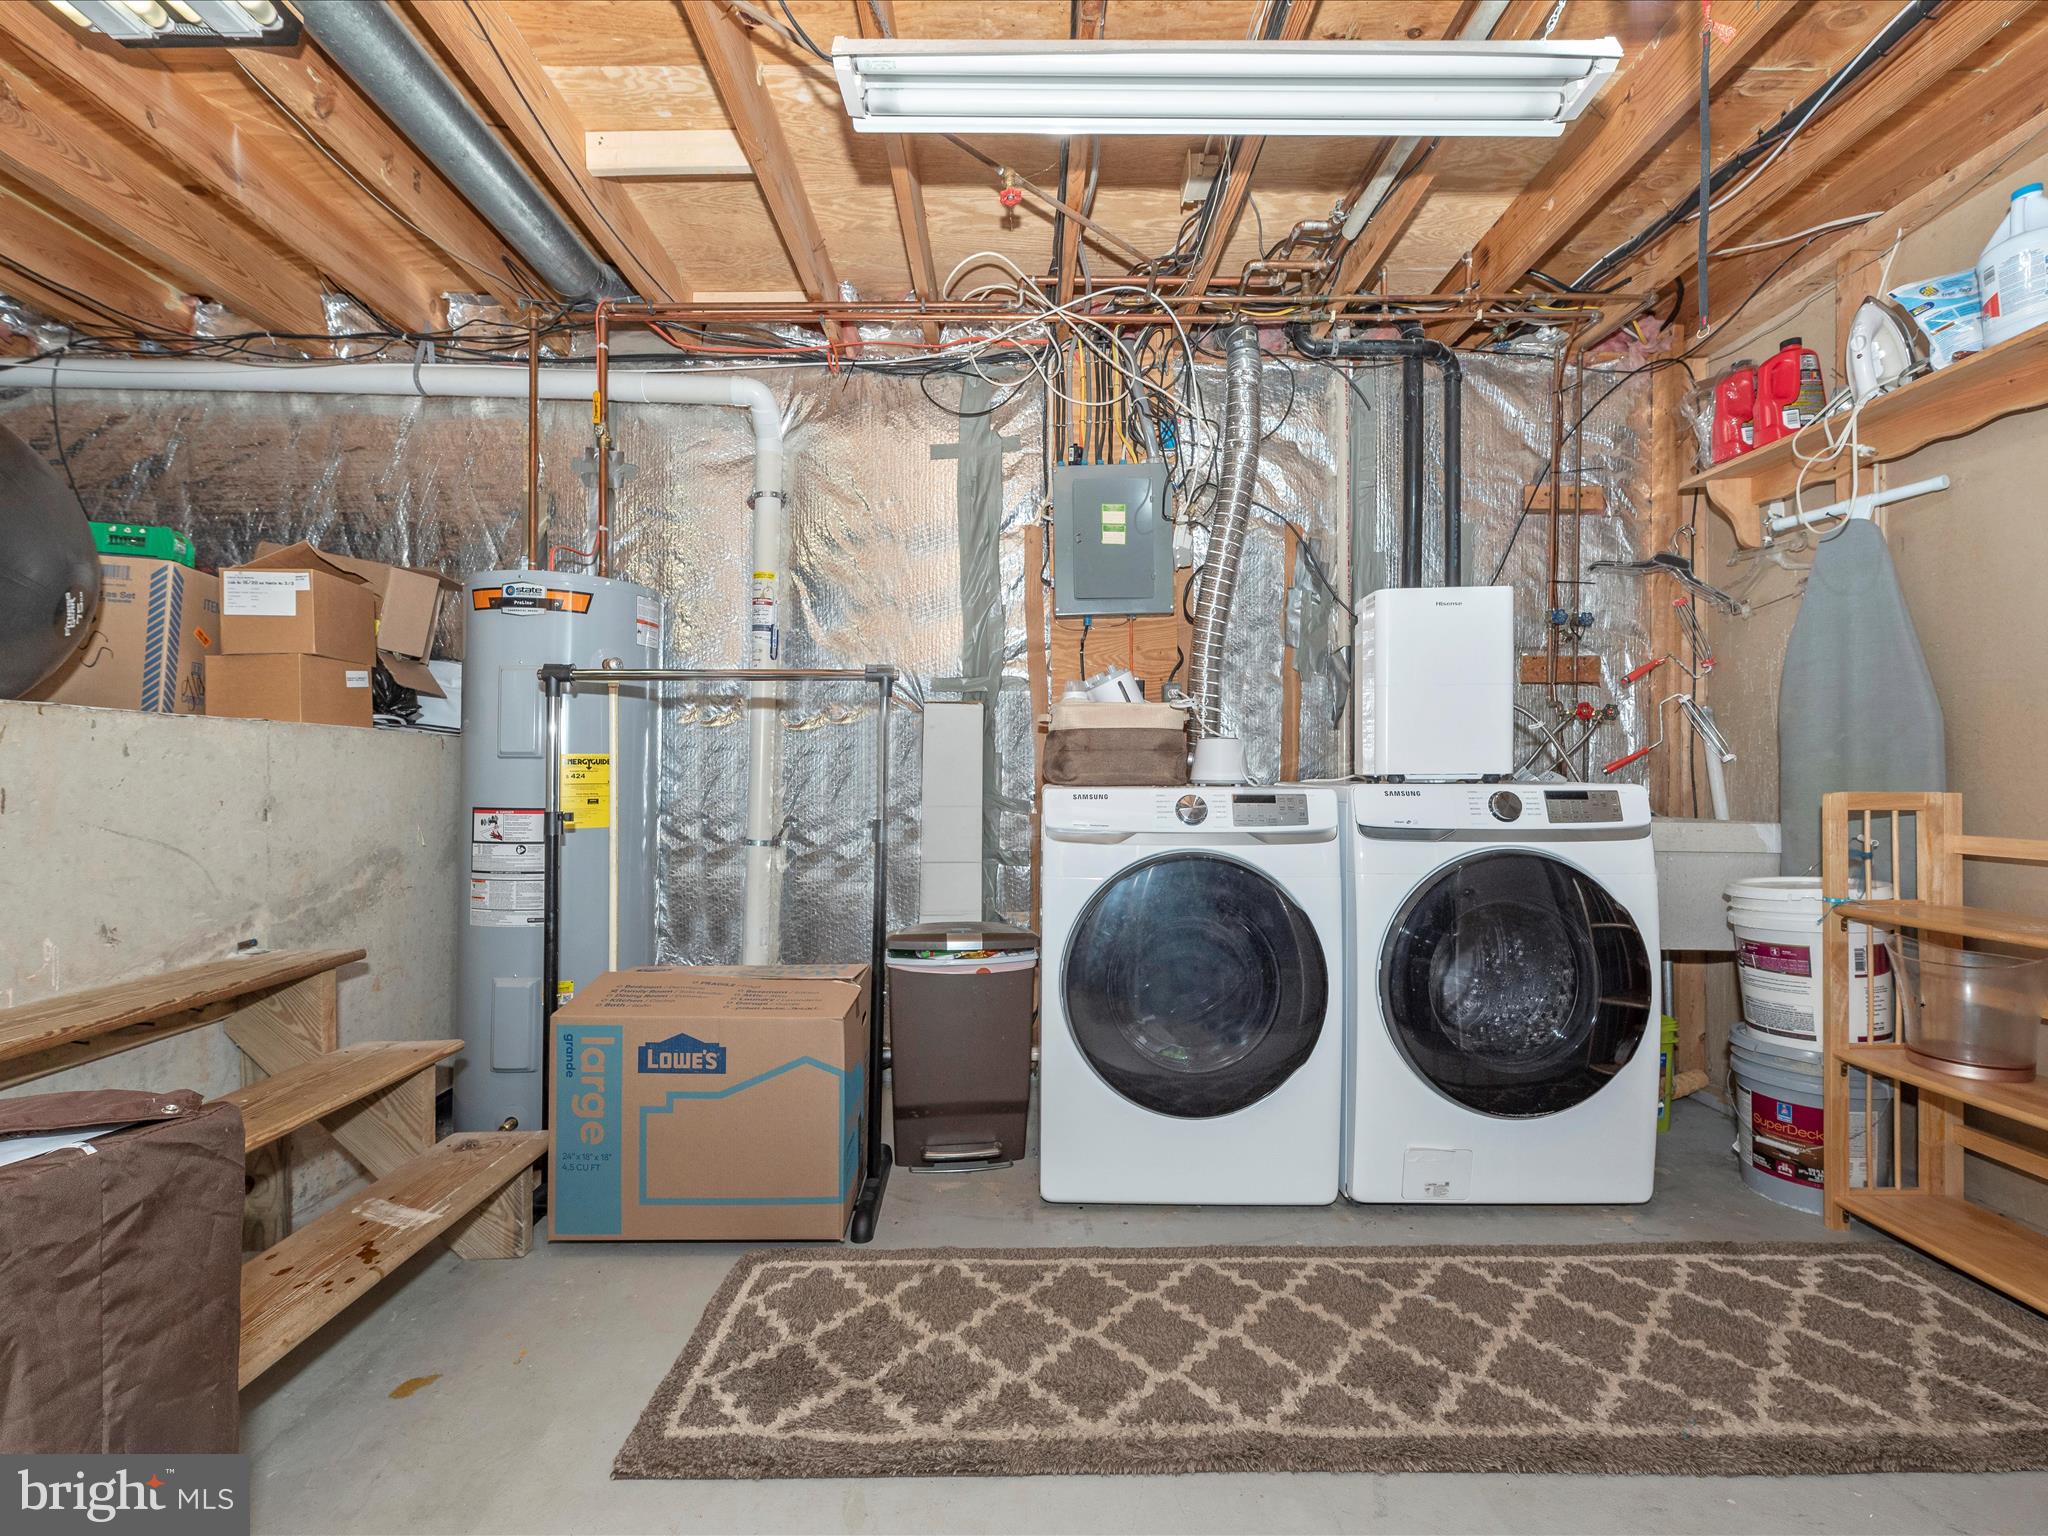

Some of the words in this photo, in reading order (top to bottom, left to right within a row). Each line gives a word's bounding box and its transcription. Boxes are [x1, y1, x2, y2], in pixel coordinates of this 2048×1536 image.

[563, 1033, 577, 1078] grande
[647, 1048, 719, 1070] LOWE'S
[570, 1036, 615, 1145] large
[1753, 1112, 1824, 1141] SuperDeck
[576, 1163, 589, 1171] CU
[590, 1163, 601, 1171] FT
